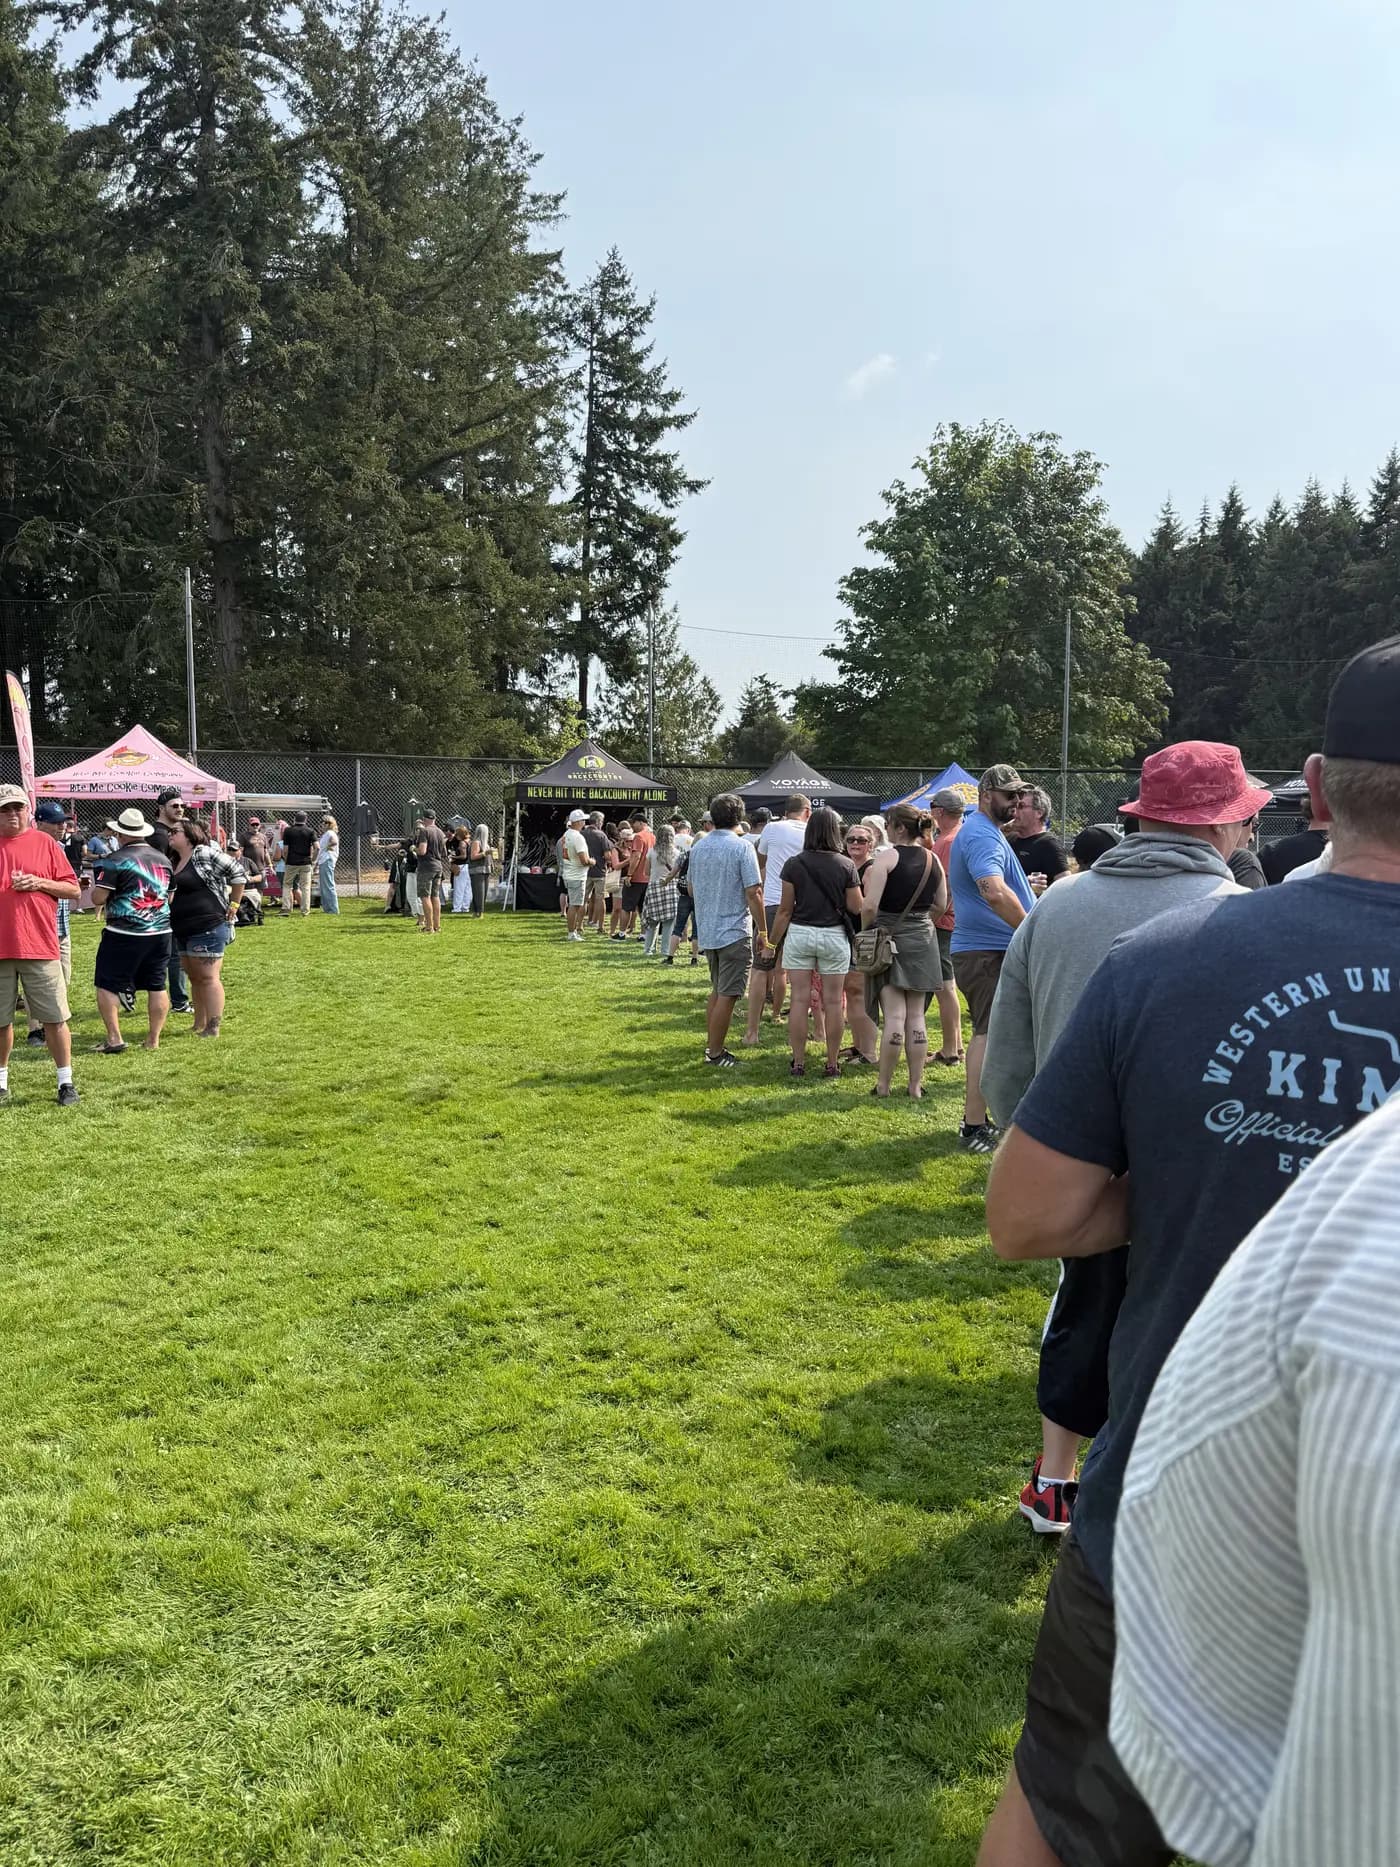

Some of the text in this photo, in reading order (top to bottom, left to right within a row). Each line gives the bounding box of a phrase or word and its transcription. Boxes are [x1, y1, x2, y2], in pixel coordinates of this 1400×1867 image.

[89, 783, 104, 792] Me
[770, 778, 831, 786] VOYAGE
[527, 786, 668, 801] NEVER HIT THE BACKCOUNTRY ALONE
[1202, 967, 1400, 1085] WESTERN UN
[1204, 1099, 1344, 1145] Official
